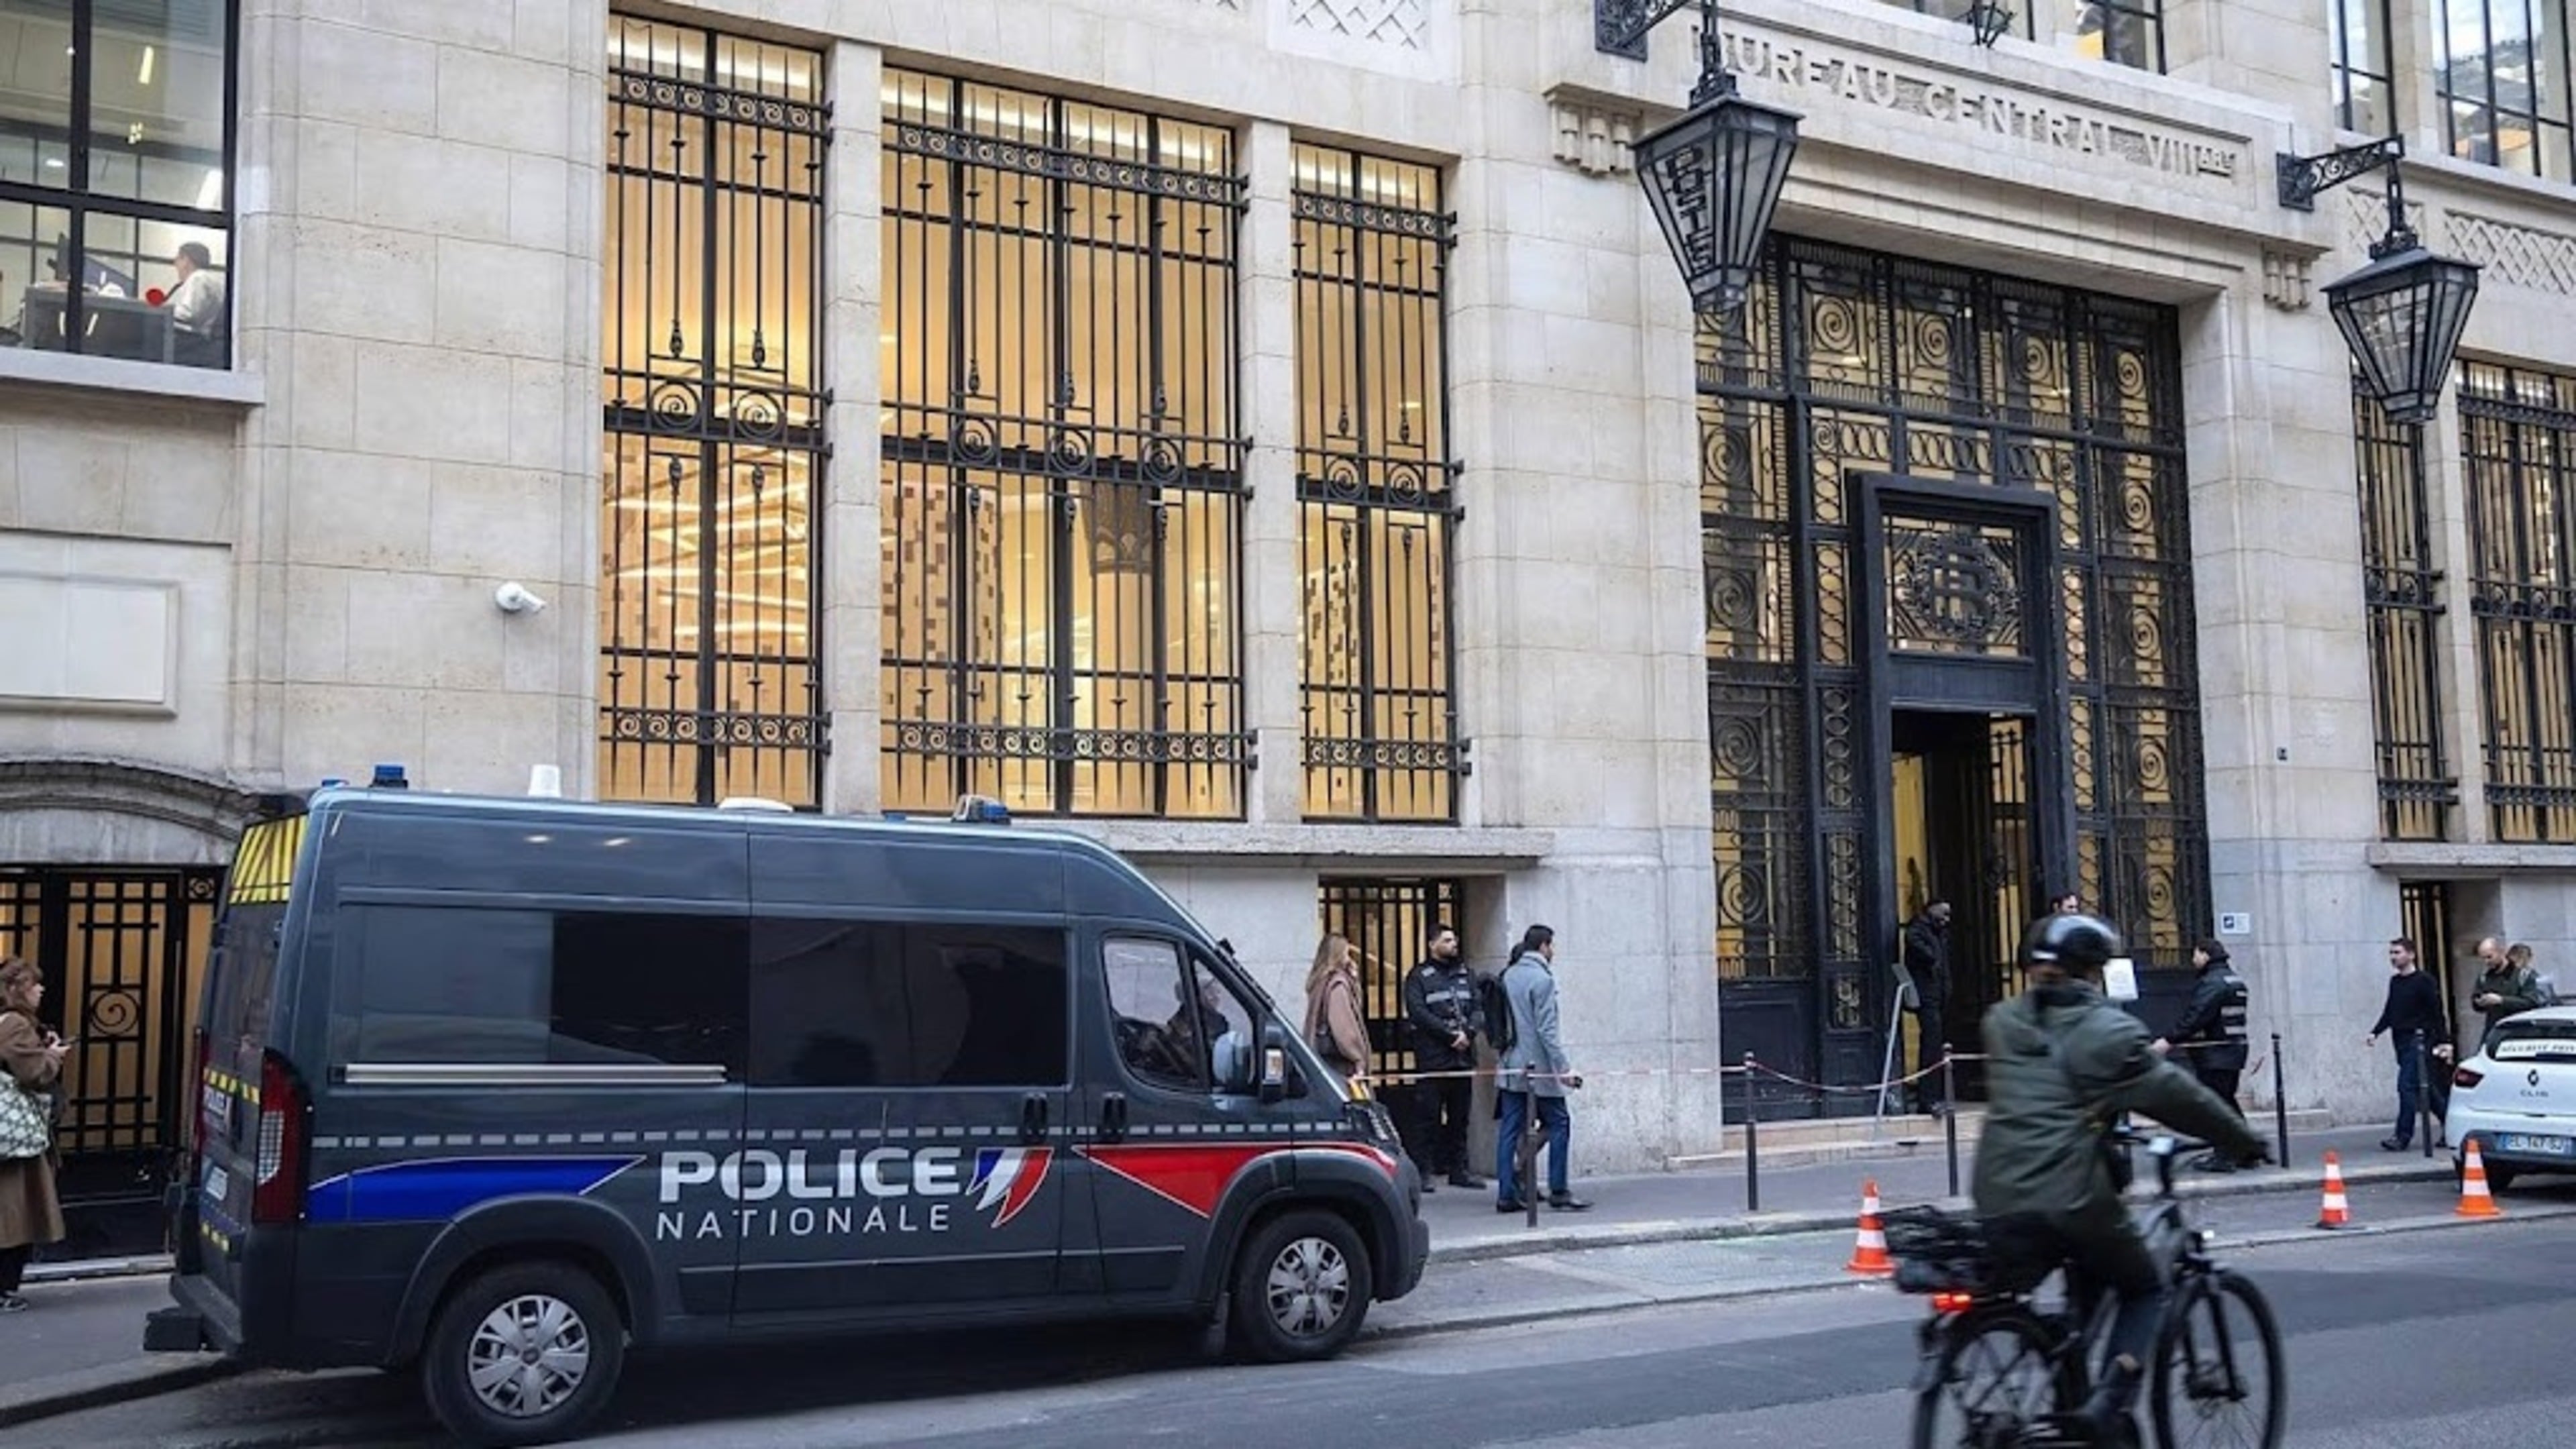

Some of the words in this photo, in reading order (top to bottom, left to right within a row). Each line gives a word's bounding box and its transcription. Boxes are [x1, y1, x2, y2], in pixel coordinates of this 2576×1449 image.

[1925, 83, 2123, 162] CENTRAL
[1666, 144, 1713, 271] POSTES
[659, 1146, 962, 1203] POLICE
[656, 1205, 951, 1240] NATIONALE
